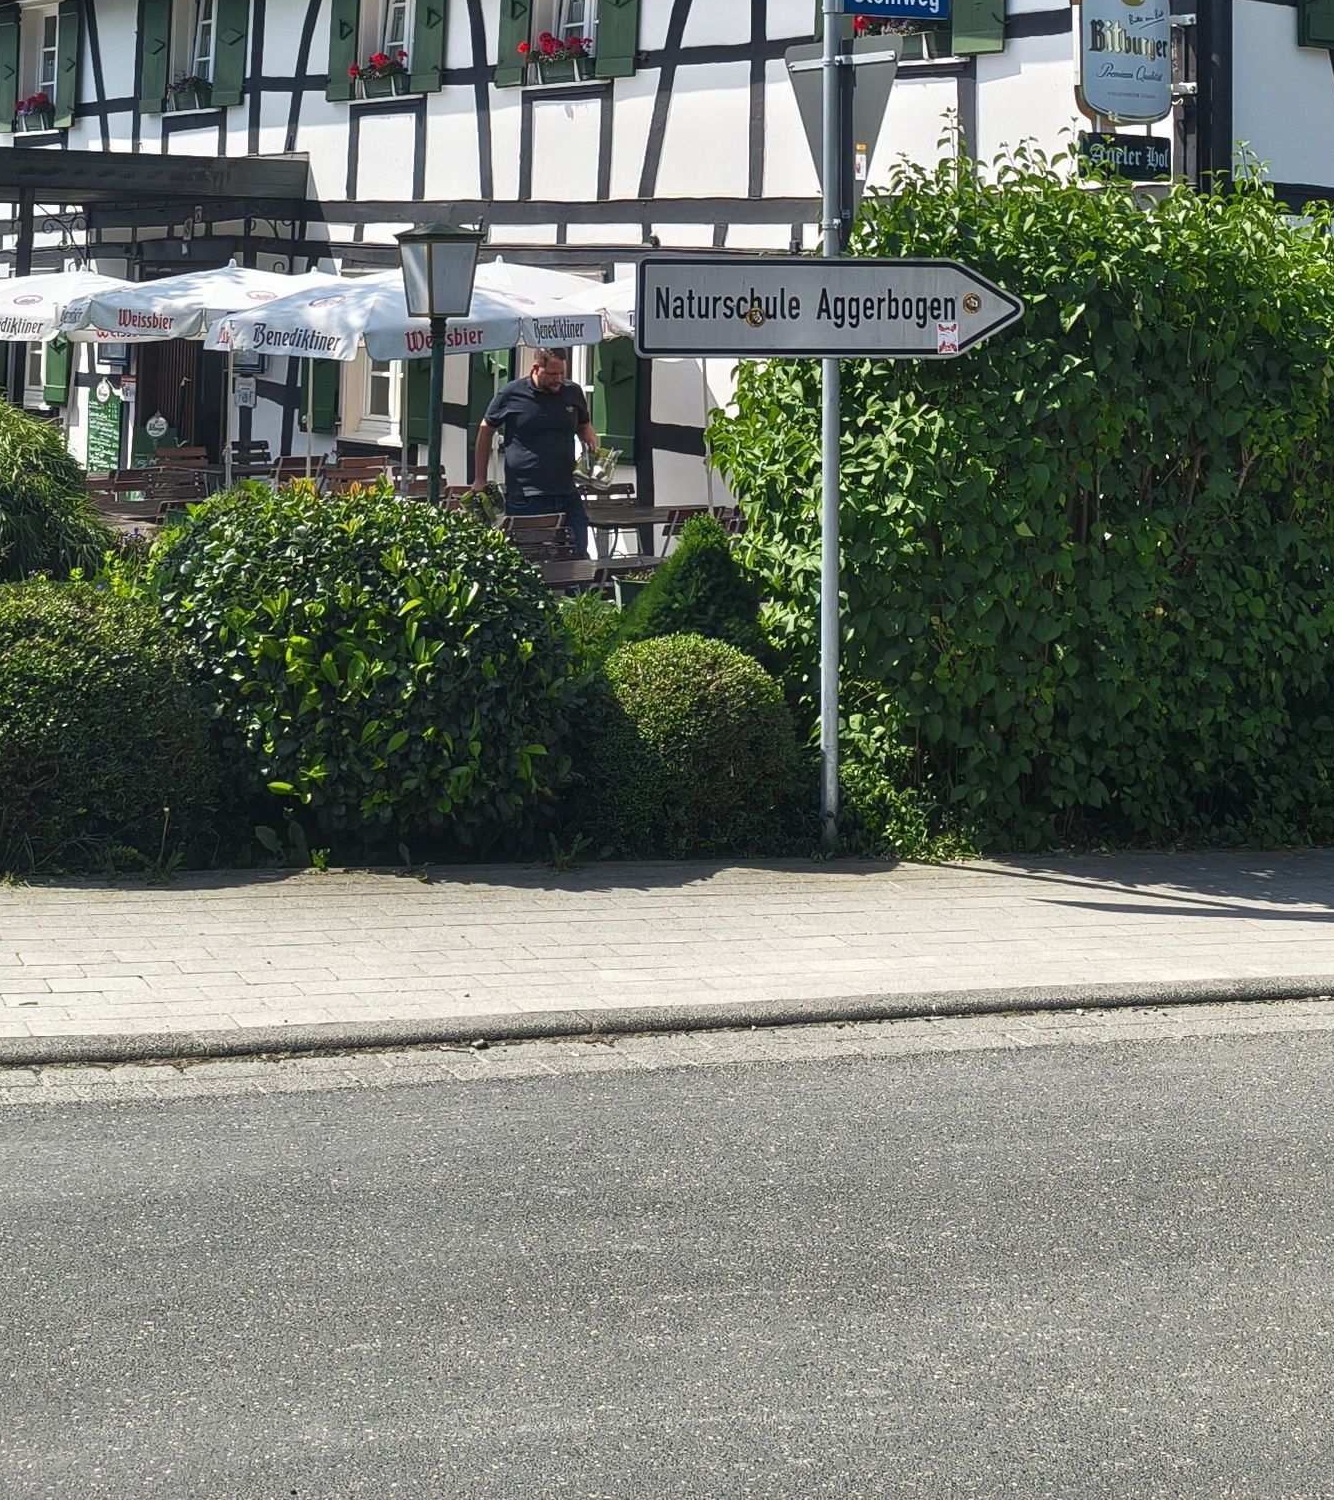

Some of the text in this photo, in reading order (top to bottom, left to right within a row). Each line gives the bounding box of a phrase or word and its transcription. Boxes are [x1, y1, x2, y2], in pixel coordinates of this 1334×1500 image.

[1089, 18, 1168, 62] Bitburger
[118, 308, 174, 330] Weissbier
[655, 286, 957, 329] Naturschule Aggerbogen
[253, 322, 342, 352] Benediktiner
[405, 328, 484, 352] Wesbier
[532, 318, 584, 344] Benediktiner
